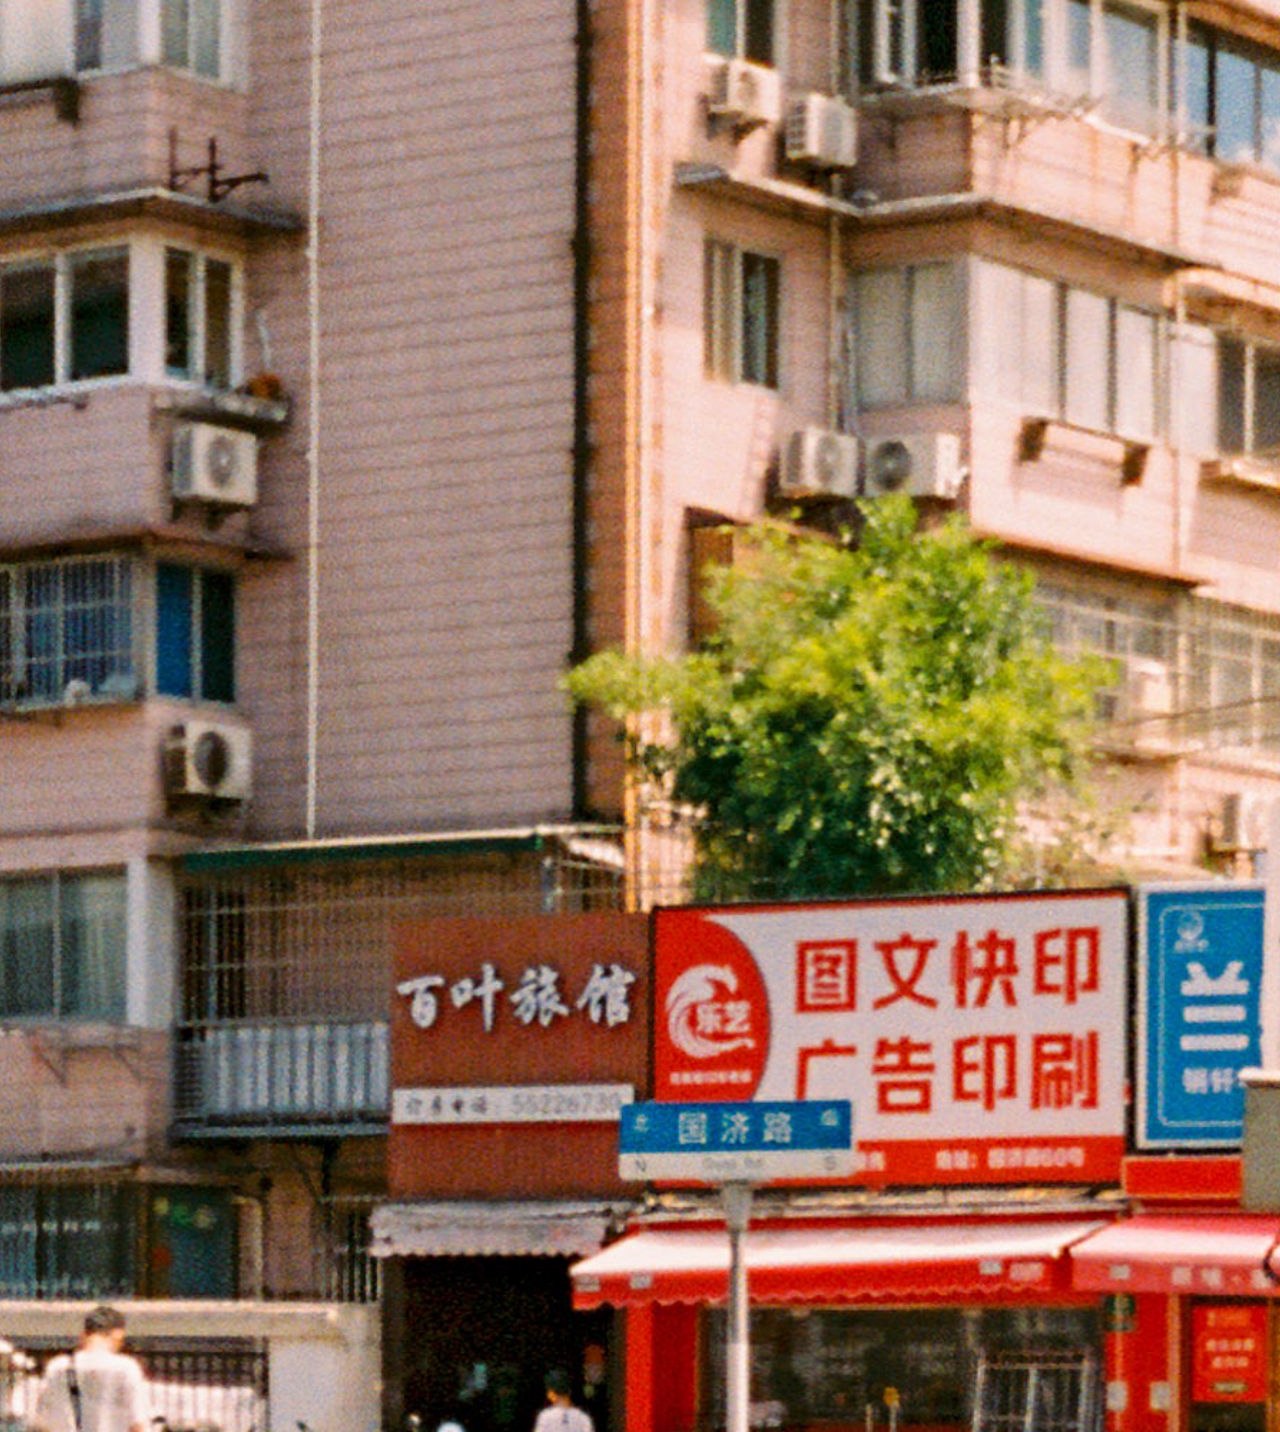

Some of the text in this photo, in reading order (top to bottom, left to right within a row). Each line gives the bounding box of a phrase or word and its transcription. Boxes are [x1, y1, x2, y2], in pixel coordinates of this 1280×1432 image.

[397, 963, 636, 1032] 百叶旅馆
[795, 927, 1100, 1014] 图文快印
[795, 1030, 1099, 1113] 广告印刷
[678, 1111, 793, 1145] 国济路
